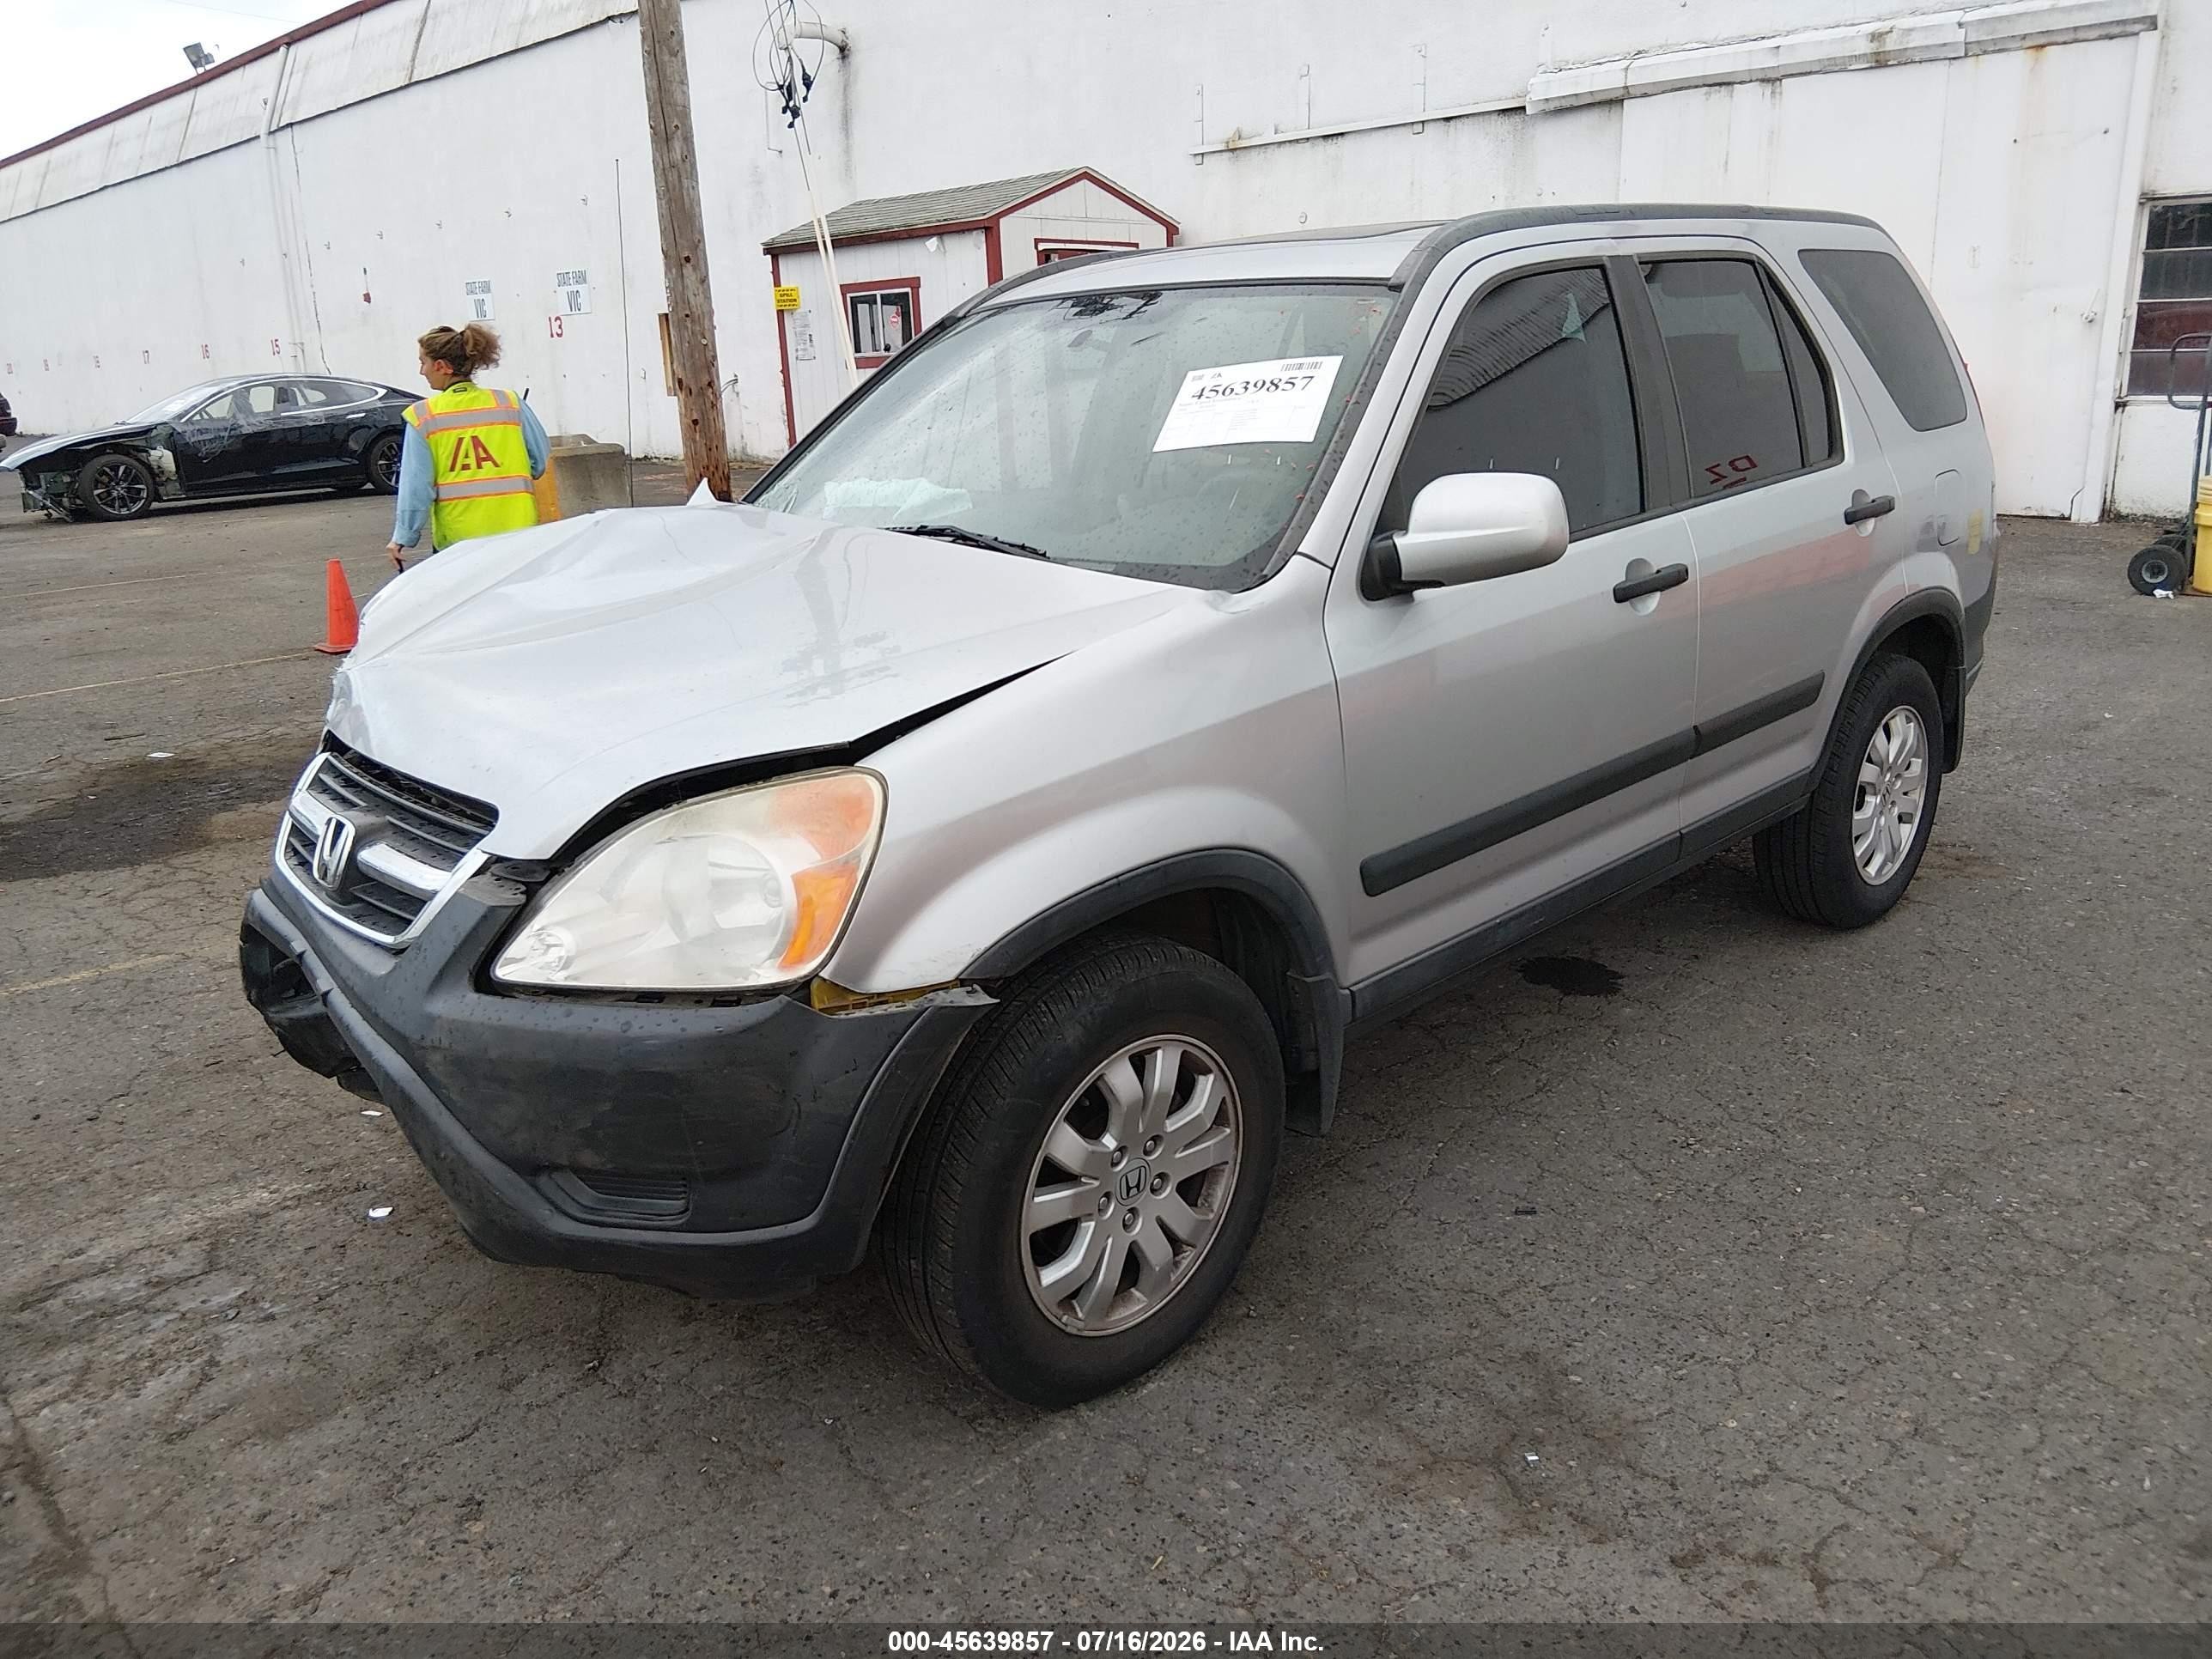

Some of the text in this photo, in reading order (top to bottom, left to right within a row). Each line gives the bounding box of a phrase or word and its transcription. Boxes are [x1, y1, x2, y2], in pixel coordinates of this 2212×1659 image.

[556, 269, 587, 288] STATE FARM
[473, 298, 487, 319] VIC
[567, 289, 581, 313] VIC
[548, 315, 563, 338] 13
[201, 344, 210, 359] 16
[270, 338, 281, 356] 15
[1191, 375, 1316, 400] 45639857
